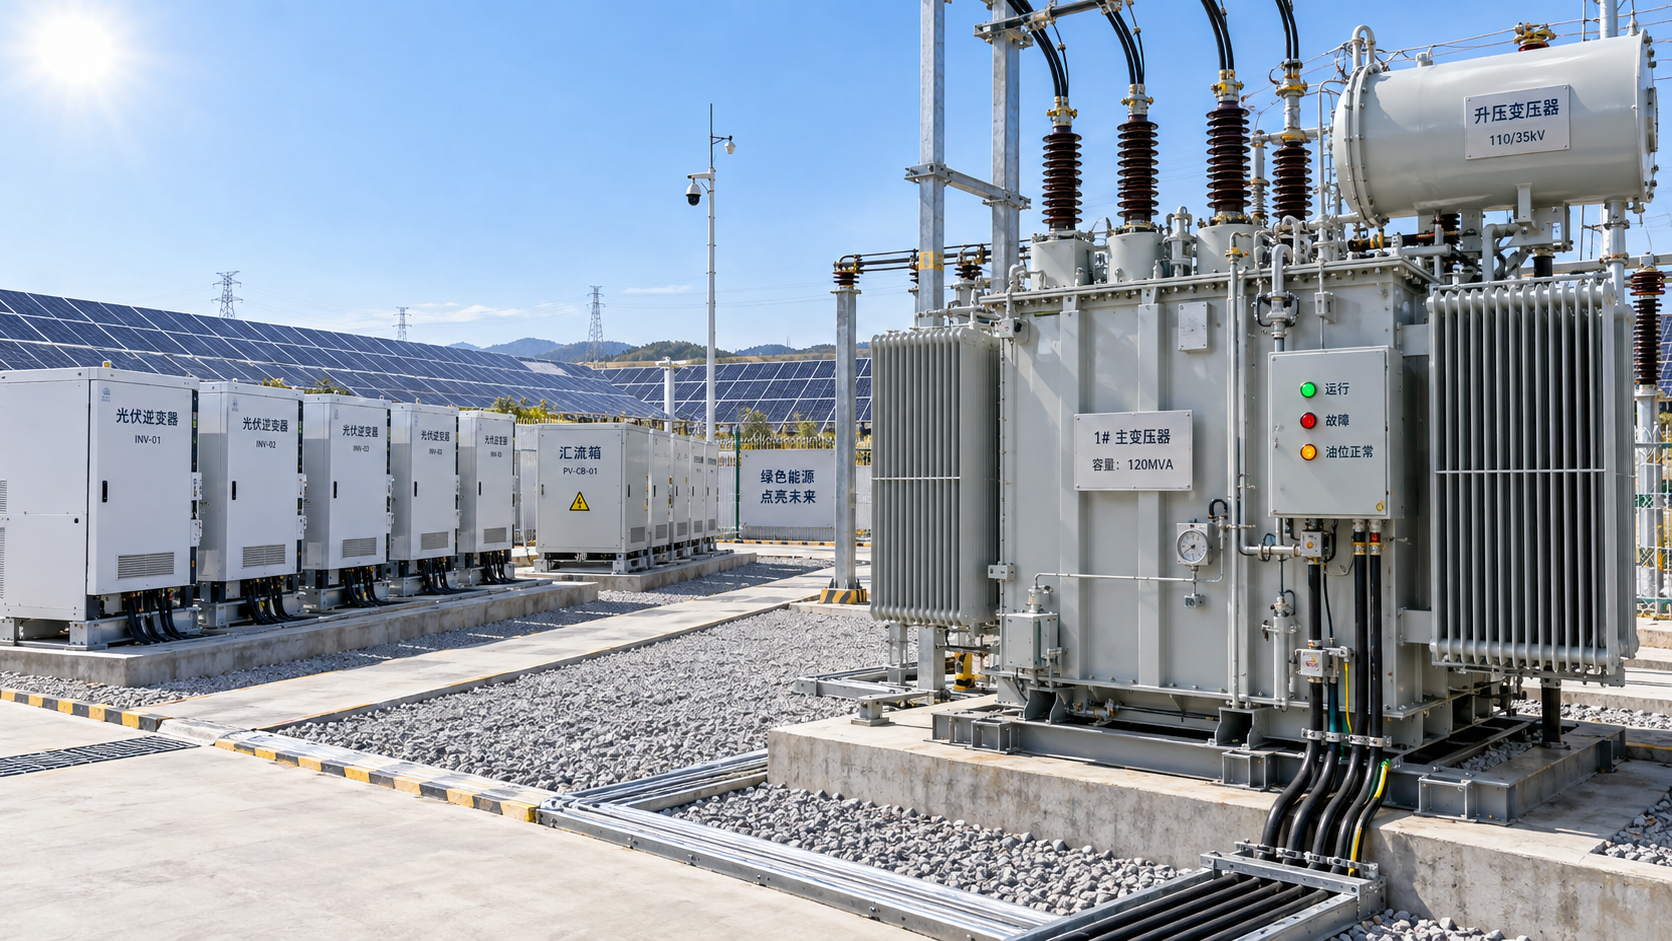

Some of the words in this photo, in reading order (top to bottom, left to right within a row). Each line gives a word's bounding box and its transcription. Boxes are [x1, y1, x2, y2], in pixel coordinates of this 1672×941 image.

[1474, 98, 1560, 125] 升压变压器
[1489, 129, 1546, 146] 110/35kV
[1324, 382, 1350, 396] 运行
[115, 407, 179, 427] 光伏逆变器
[1325, 413, 1350, 427] 故障
[134, 434, 162, 445] INV-01
[1094, 430, 1111, 445] 1#
[1114, 427, 1171, 445] 主变压器
[255, 440, 277, 450] INV-02
[559, 445, 602, 460] 汇流箱
[1325, 444, 1374, 459] 油位正常
[1127, 458, 1174, 471] 120MVA
[760, 469, 816, 485] 绿色能源
[760, 489, 817, 505] 点亮未来
